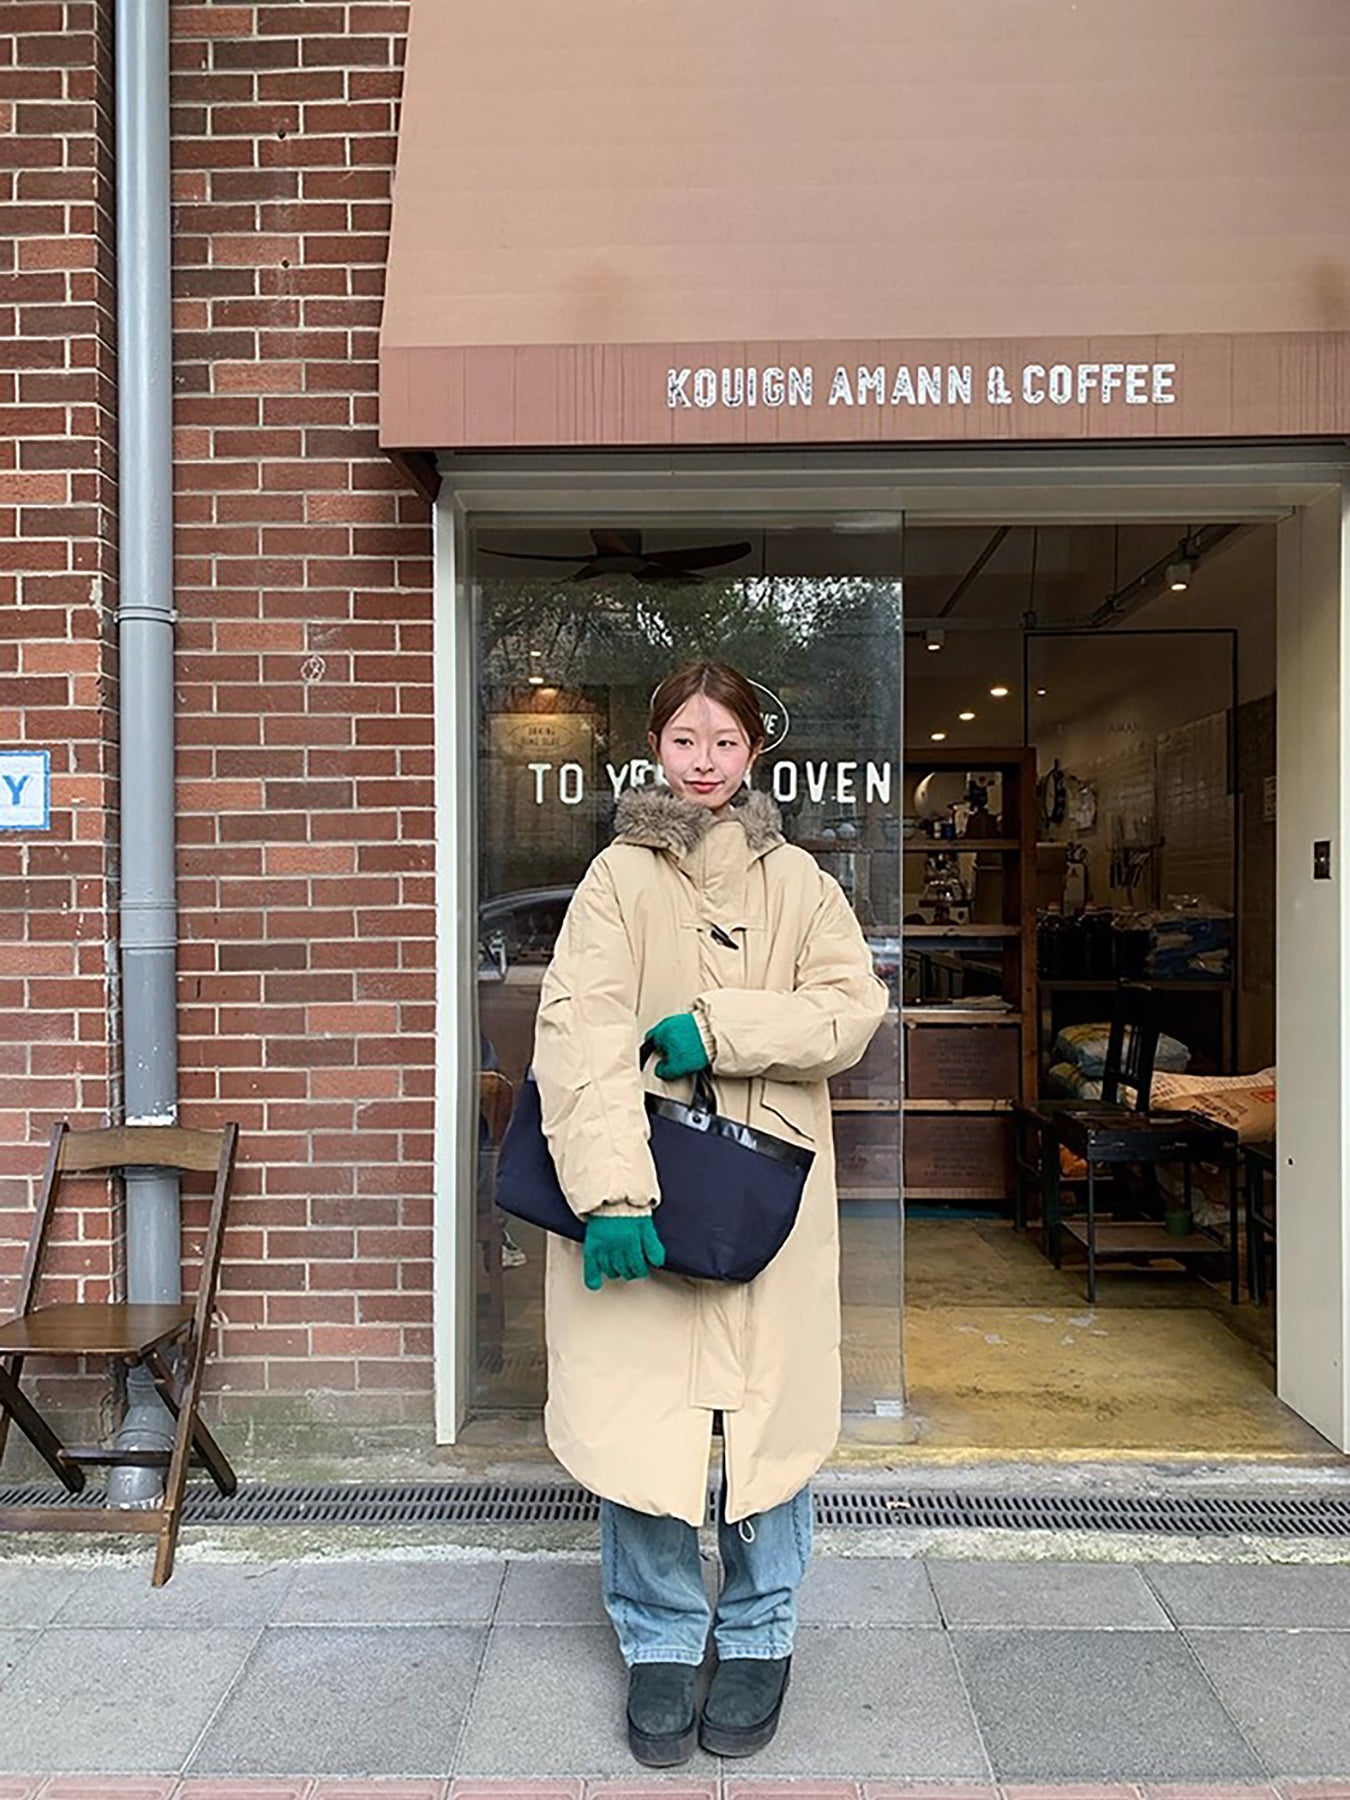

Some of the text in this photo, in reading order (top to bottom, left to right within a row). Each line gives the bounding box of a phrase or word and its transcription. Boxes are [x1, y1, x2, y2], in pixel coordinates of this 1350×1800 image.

[667, 363, 1177, 408] KOUIGN AMANN & COFFEE
[527, 763, 583, 804] TO
[774, 761, 891, 804] OVEN
